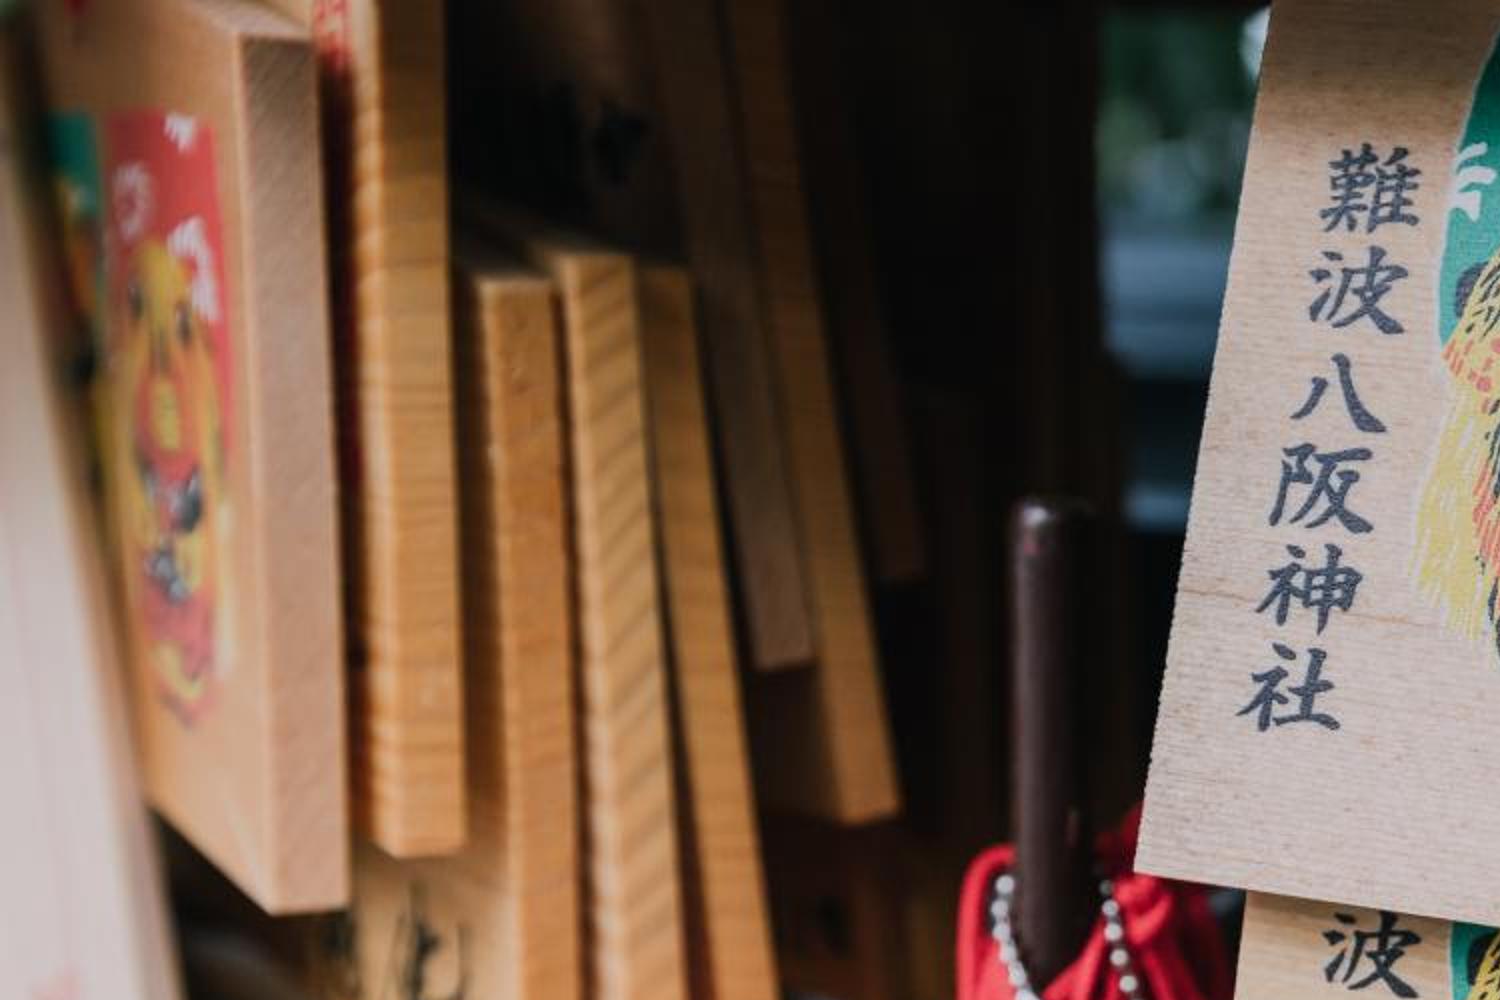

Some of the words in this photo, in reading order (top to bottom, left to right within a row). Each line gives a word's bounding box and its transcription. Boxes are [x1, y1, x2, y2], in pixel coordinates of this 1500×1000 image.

[1236, 142, 1421, 732] 難波八阪神社
